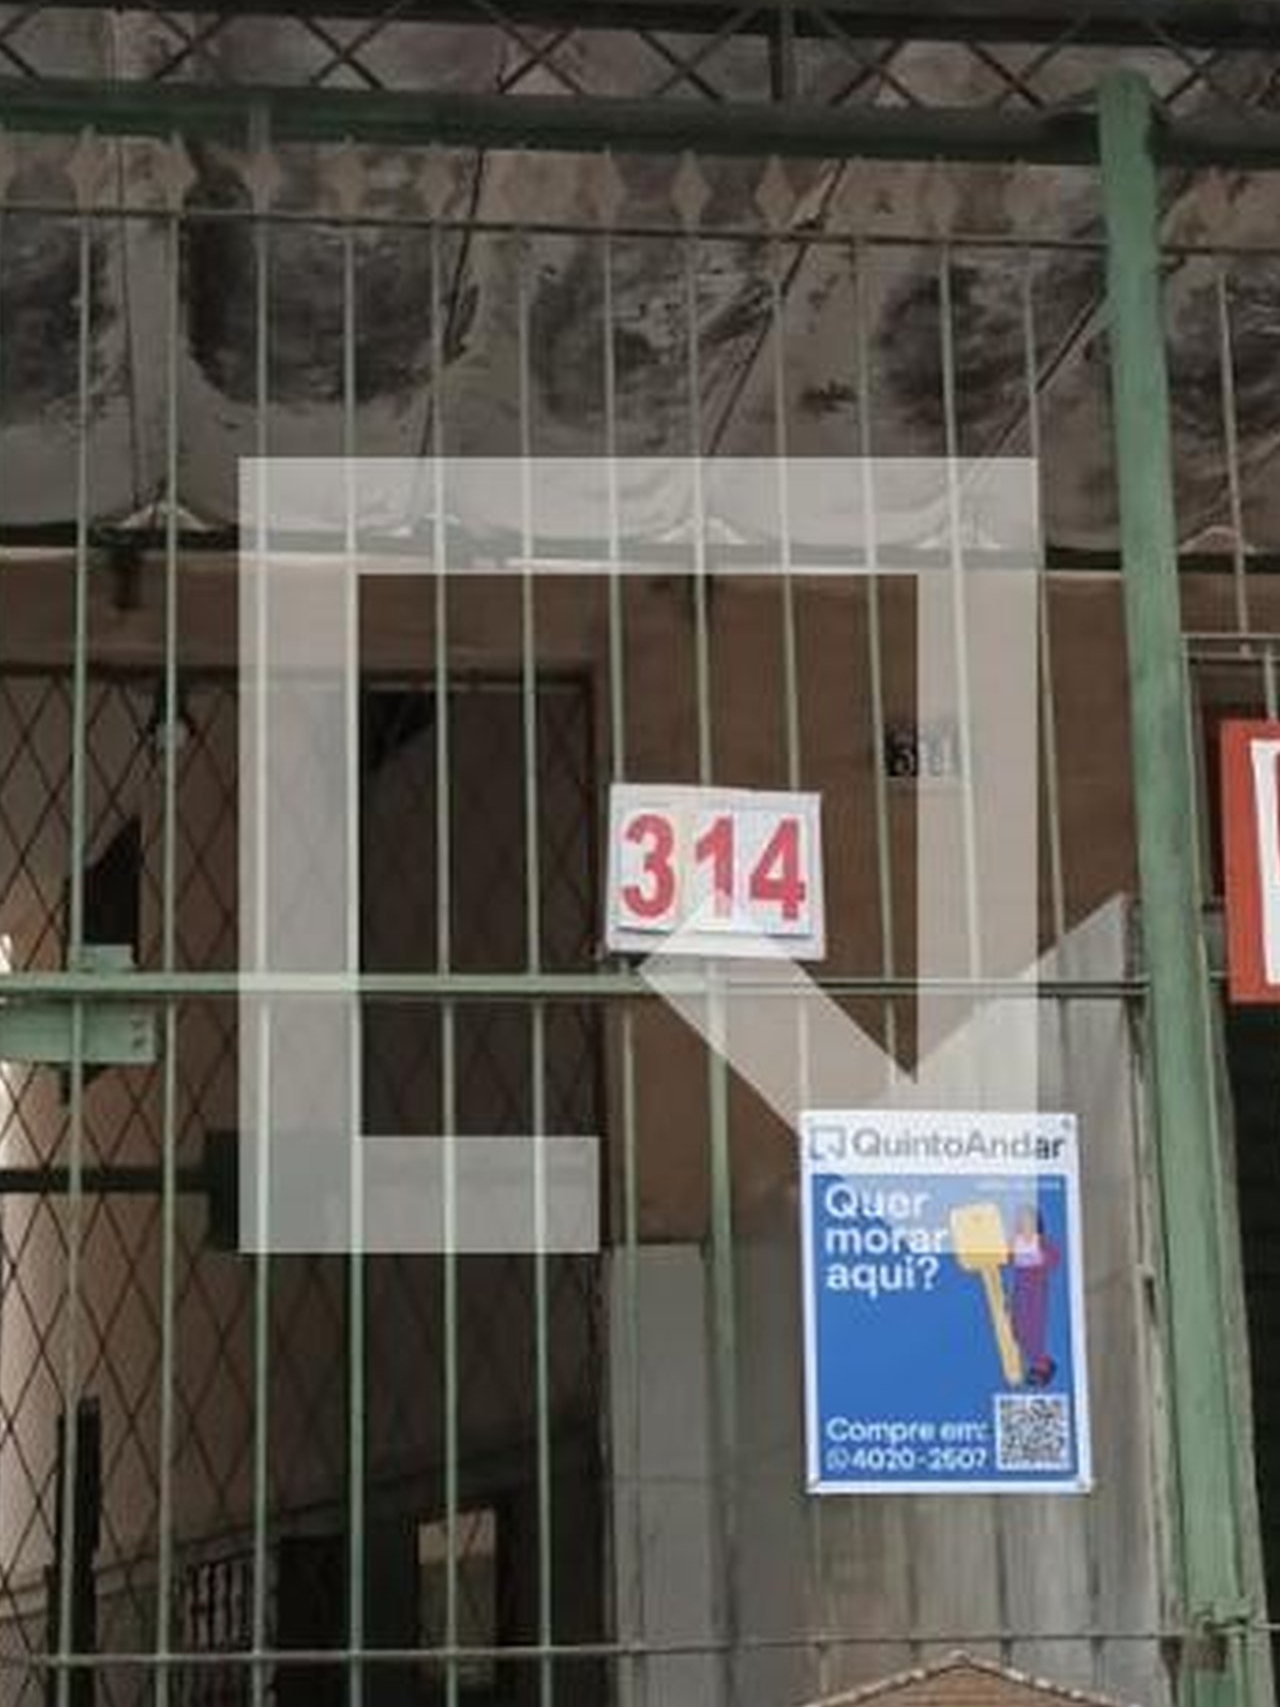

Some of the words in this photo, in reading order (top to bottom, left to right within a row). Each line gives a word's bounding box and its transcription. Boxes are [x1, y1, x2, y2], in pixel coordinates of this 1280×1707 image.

[622, 814, 806, 921] 314
[852, 1128, 1065, 1160] QuintoAndar
[825, 1183, 931, 1222] Quer
[826, 1224, 950, 1255] morar
[827, 1257, 940, 1298] aqui?
